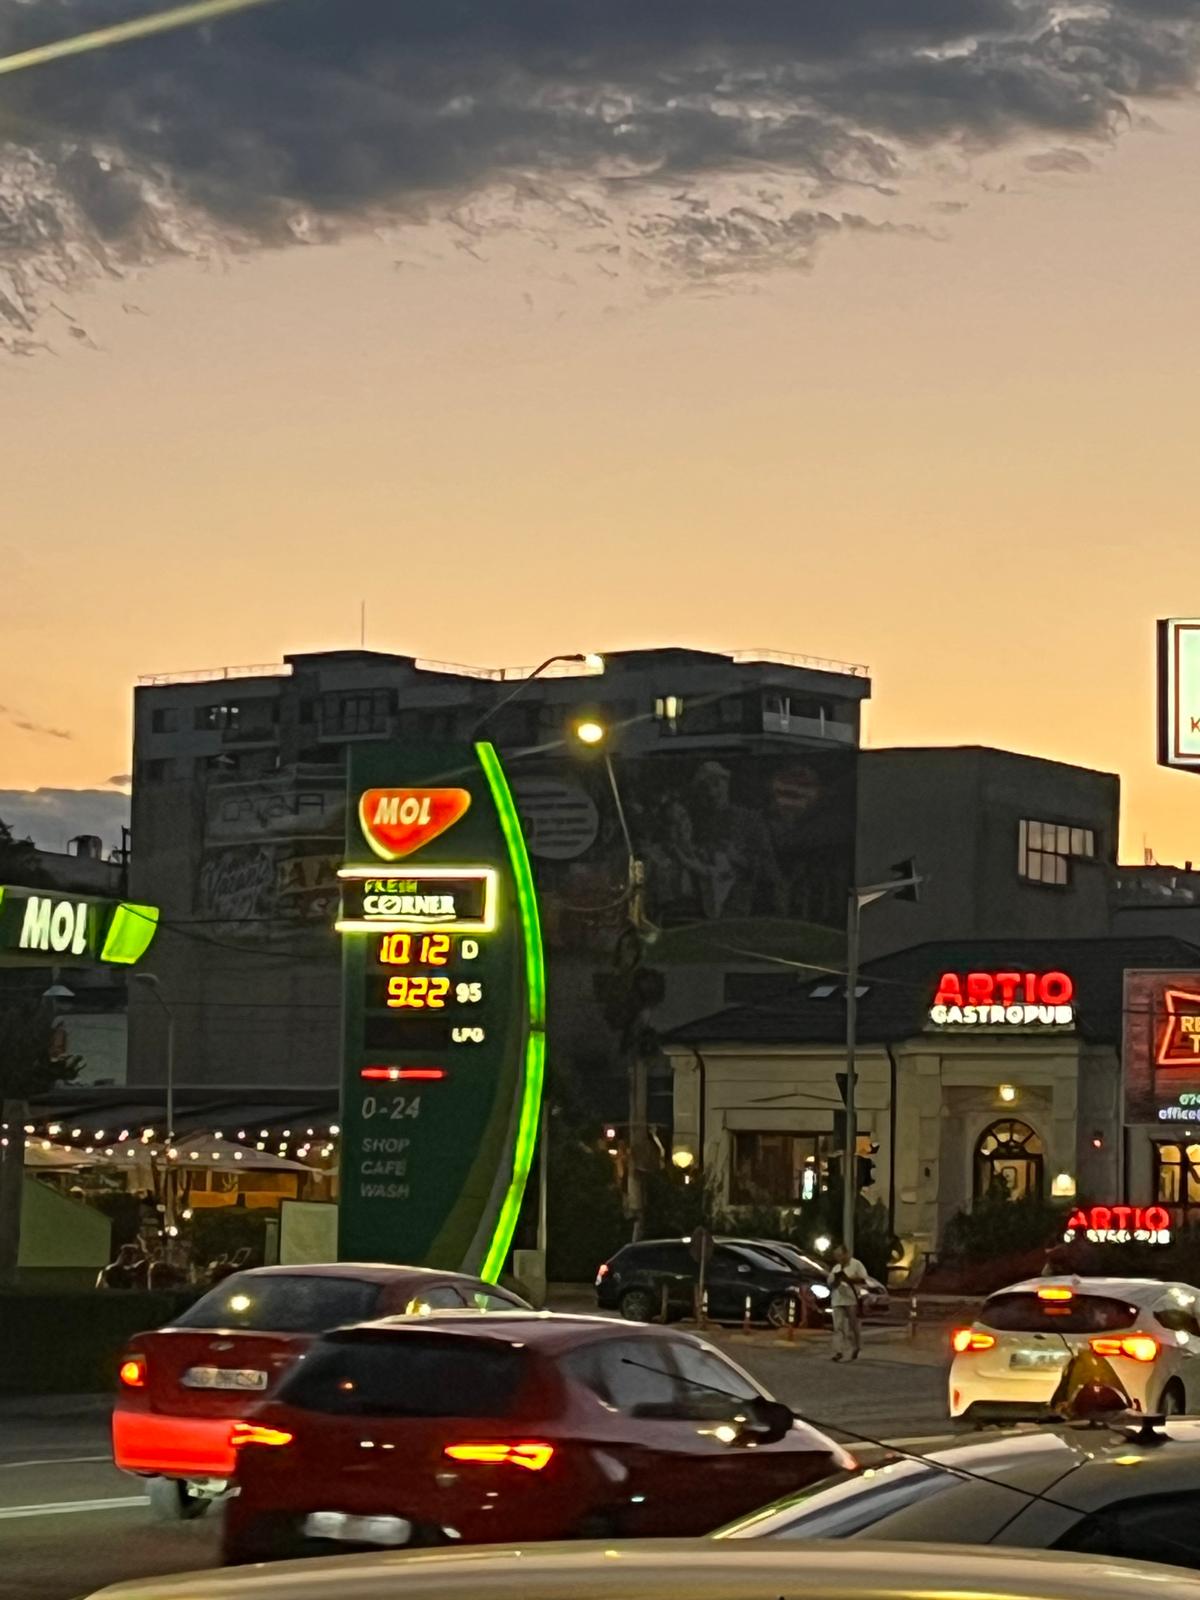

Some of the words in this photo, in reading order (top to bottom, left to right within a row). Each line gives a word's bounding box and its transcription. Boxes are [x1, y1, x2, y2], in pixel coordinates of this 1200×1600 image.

[372, 797, 431, 826] MOL
[363, 895, 456, 914] CORNER
[19, 896, 88, 955] MOL
[461, 940, 479, 959] D
[455, 983, 482, 1003] 95
[934, 972, 1073, 1005] ARTIO
[930, 1004, 1073, 1025] GASTROPUB
[361, 1096, 421, 1120] 0-24
[361, 1138, 410, 1152] SHOP
[361, 1183, 410, 1198] WASH
[1068, 1207, 1170, 1230] ARTIO
